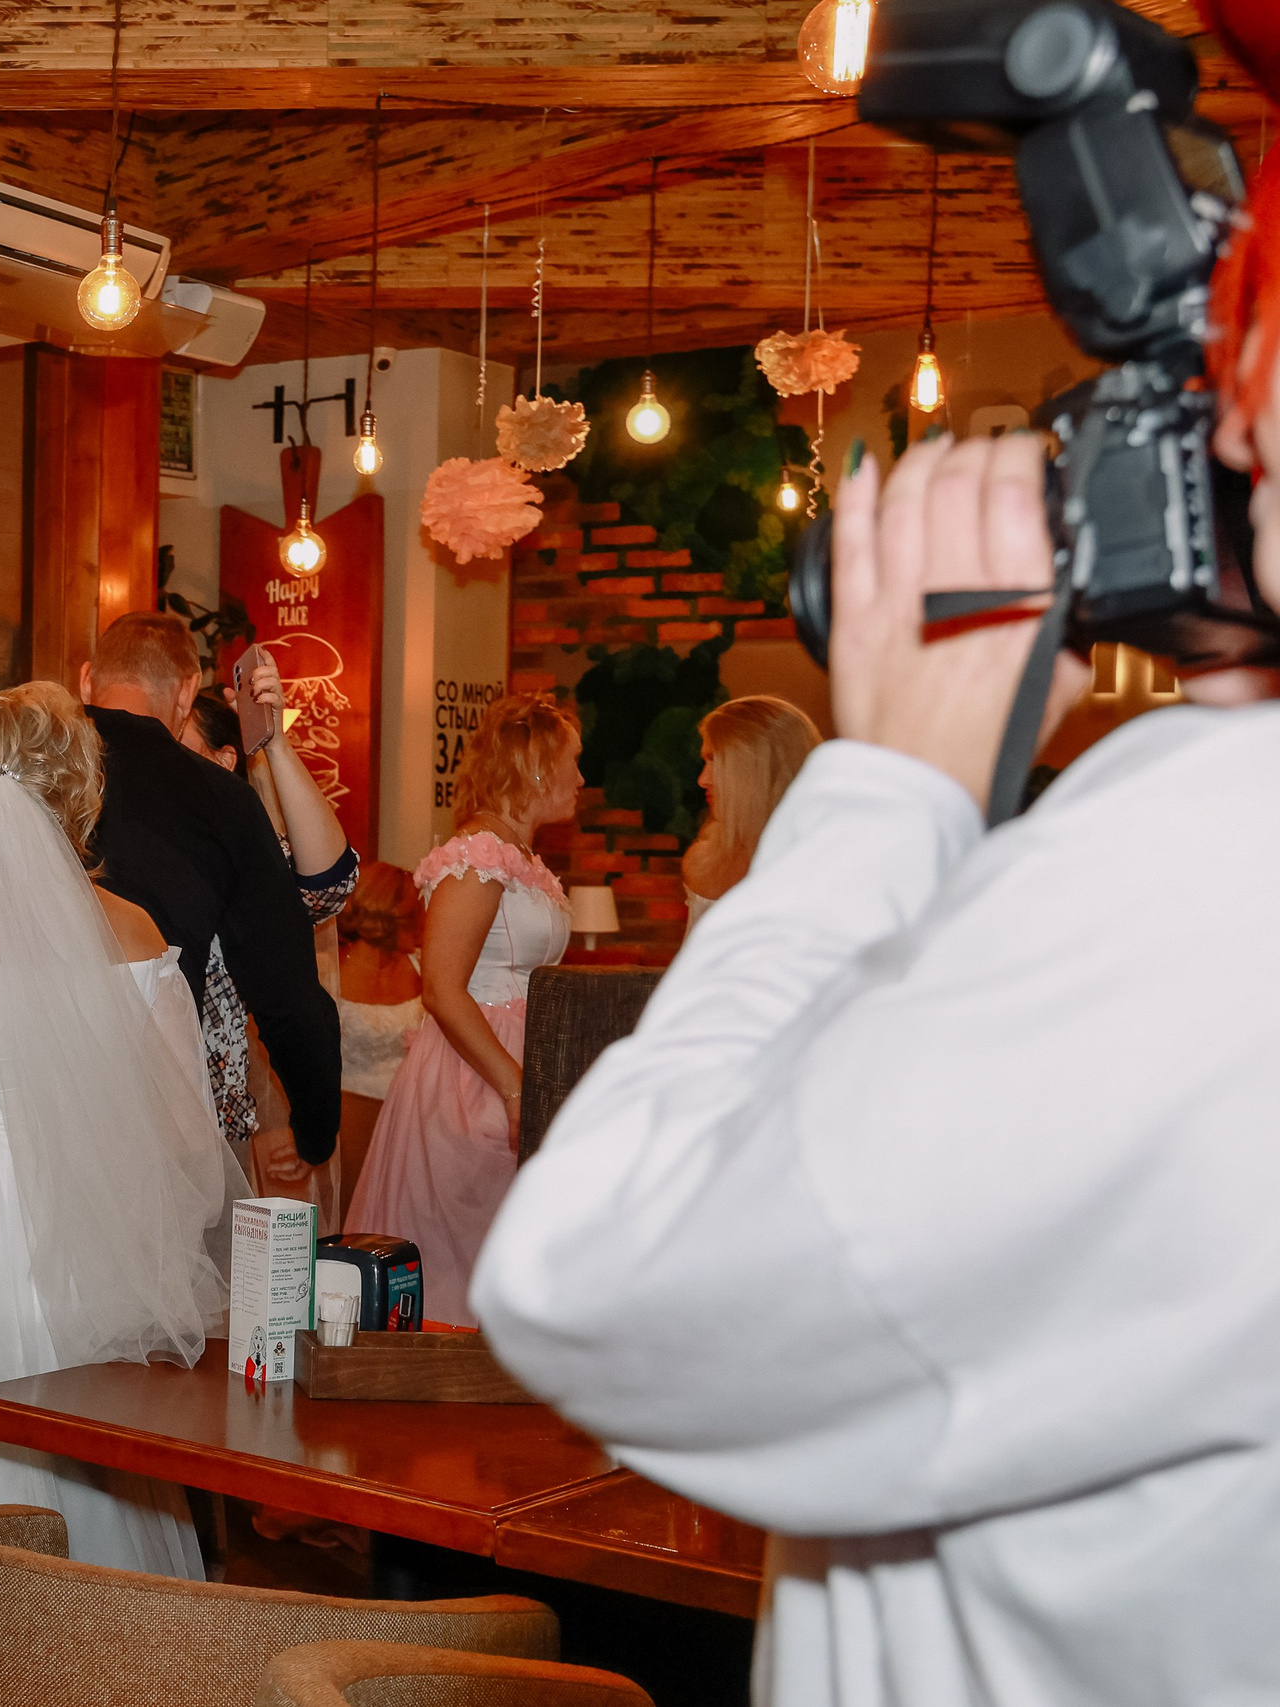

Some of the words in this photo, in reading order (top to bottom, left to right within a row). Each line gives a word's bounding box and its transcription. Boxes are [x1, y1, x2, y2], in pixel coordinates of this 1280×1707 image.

[266, 575, 320, 604] Happy
[277, 605, 308, 627] PLACE
[435, 679, 459, 702] СО
[461, 681, 504, 705] МНОЙ
[435, 704, 484, 731] СТЫД
[435, 781, 458, 808] ВЕ
[276, 1212, 307, 1222] АКЦИИ
